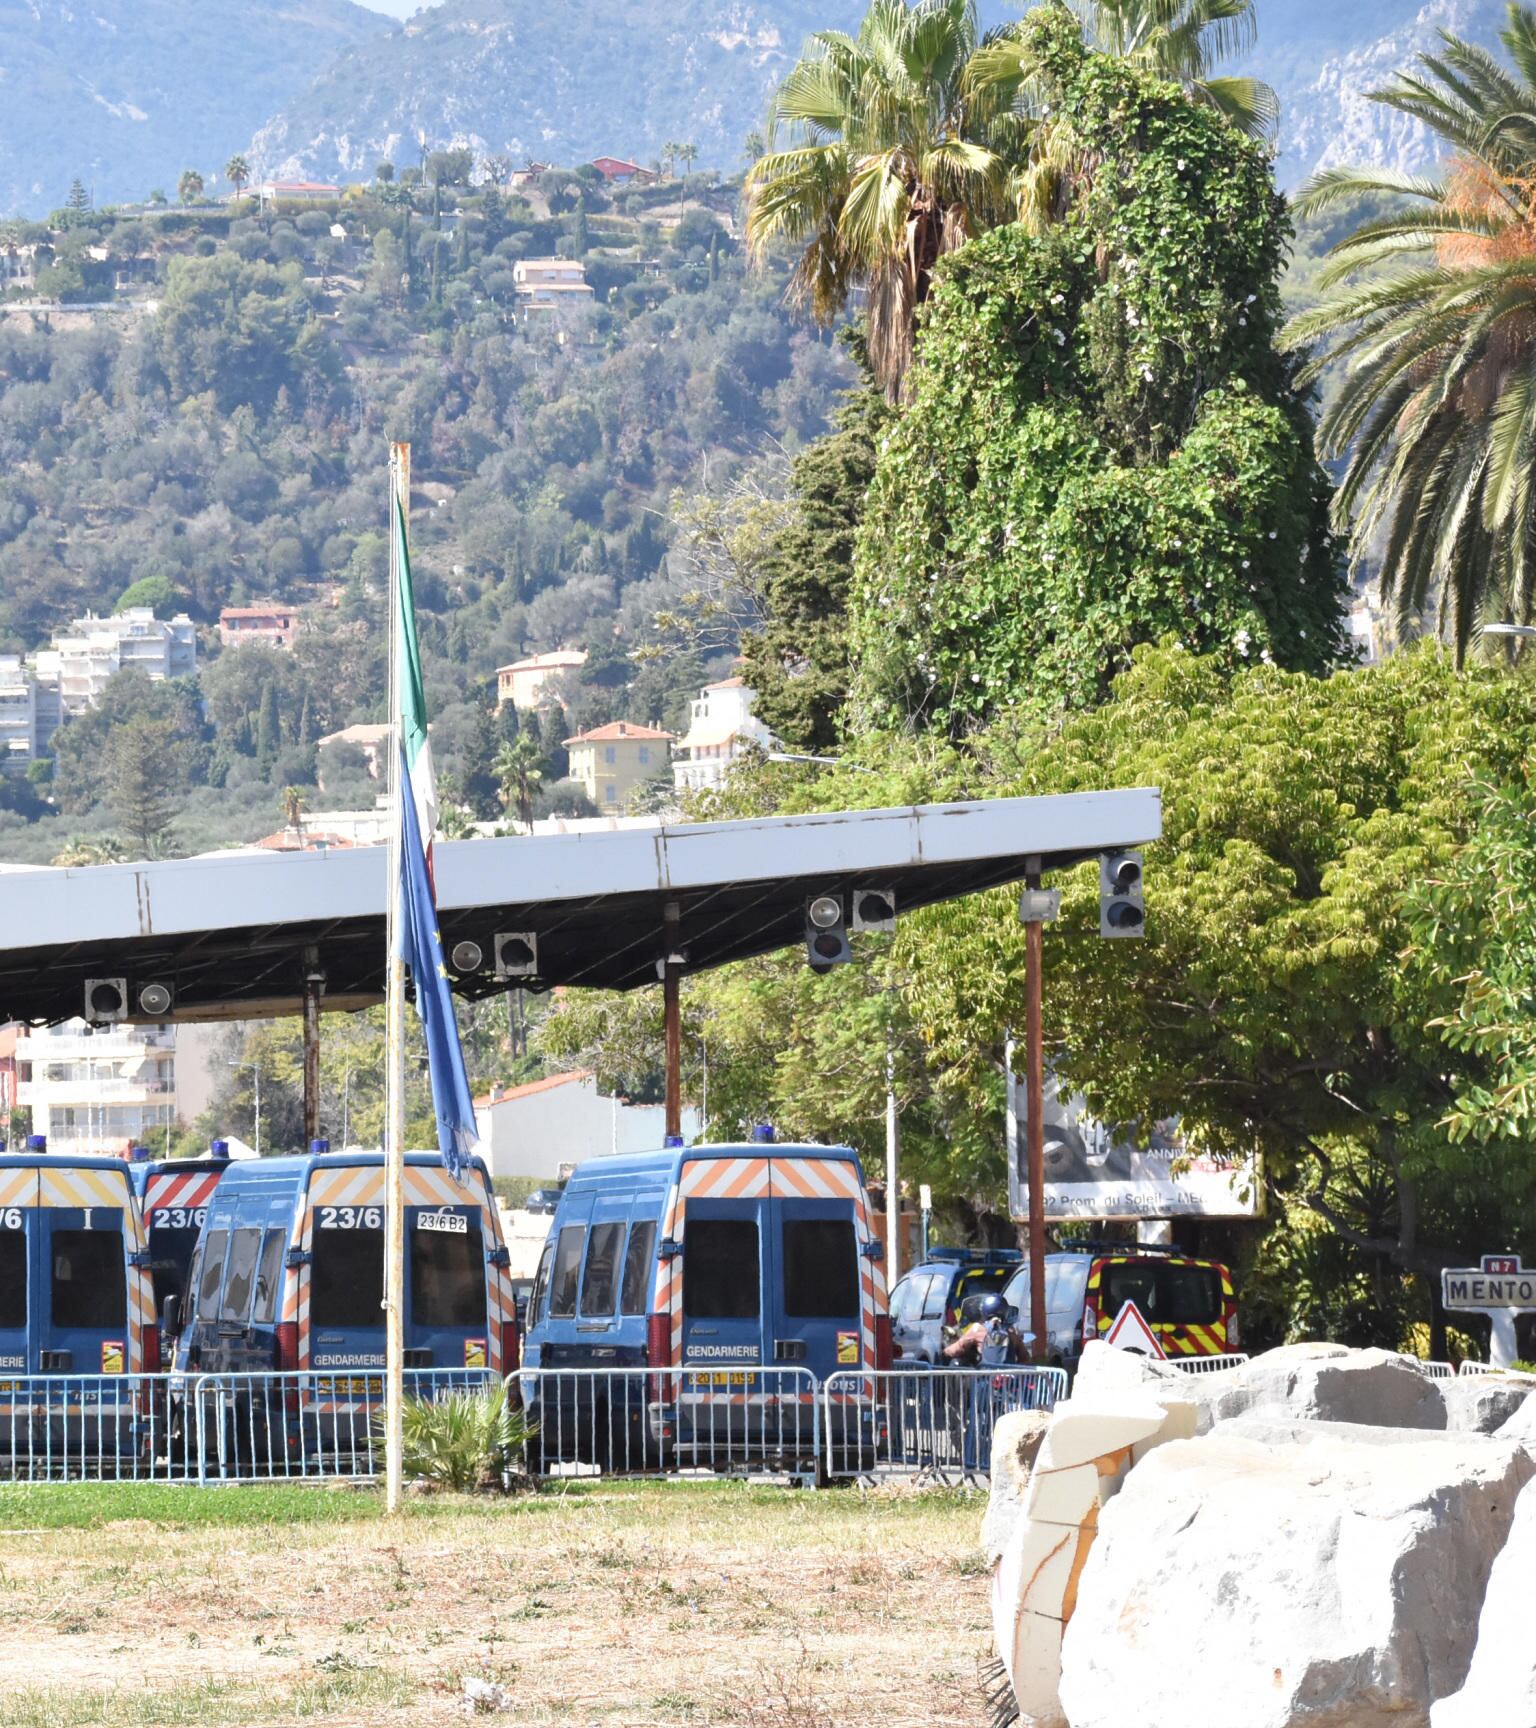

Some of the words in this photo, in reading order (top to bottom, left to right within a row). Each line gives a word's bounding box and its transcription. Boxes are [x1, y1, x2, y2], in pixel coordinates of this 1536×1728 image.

[1105, 1194, 1121, 1206] du
[1125, 1192, 1163, 1206] Soleil
[83, 1208, 93, 1230] I
[154, 1208, 207, 1229] 23/6
[320, 1207, 382, 1229] 23/6
[420, 1214, 447, 1230] 23/6
[449, 1216, 465, 1230] B2
[686, 1345, 759, 1357] GENDARMERIE
[314, 1353, 386, 1366] GENDARMERIE
